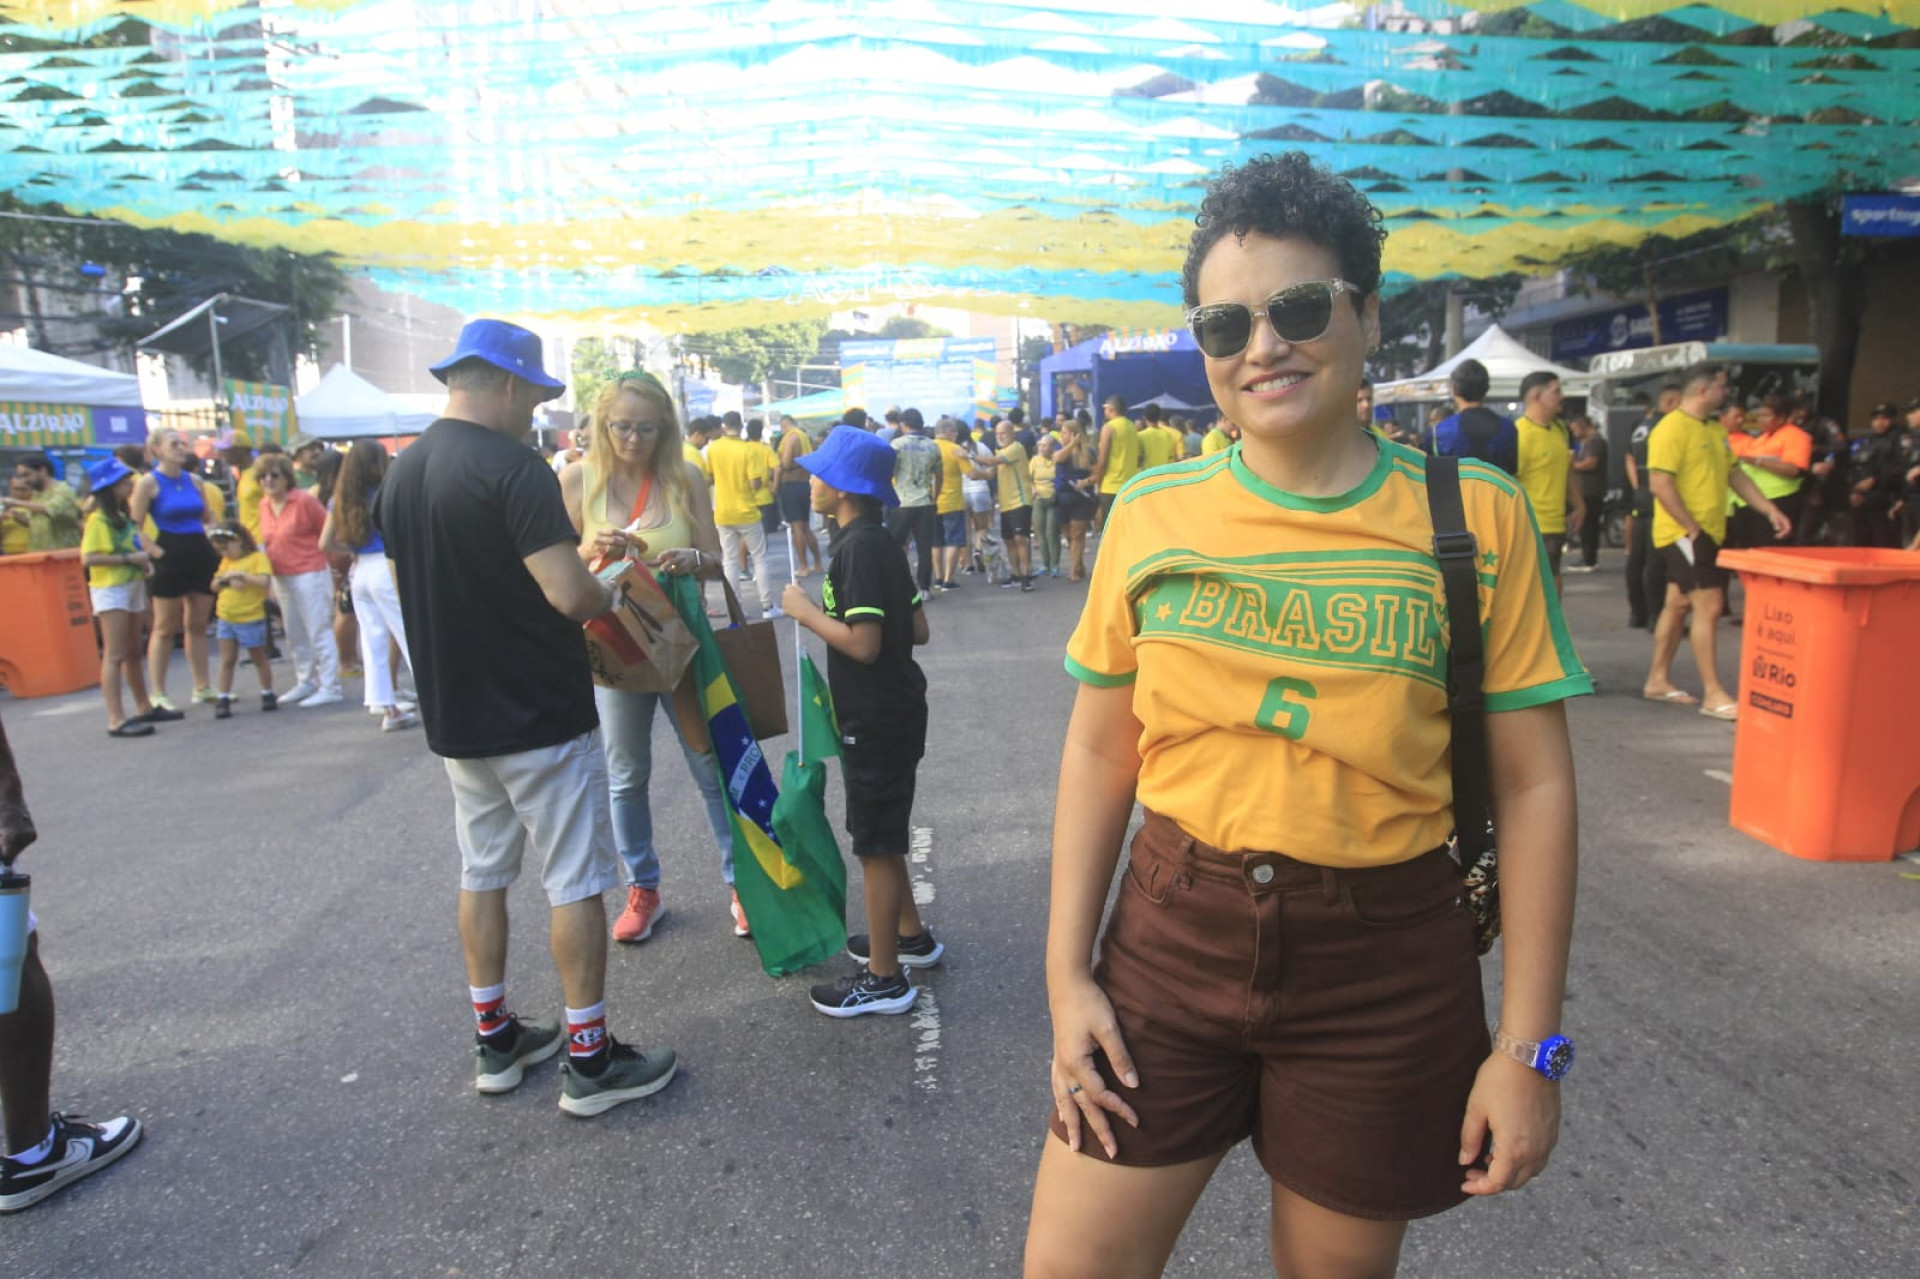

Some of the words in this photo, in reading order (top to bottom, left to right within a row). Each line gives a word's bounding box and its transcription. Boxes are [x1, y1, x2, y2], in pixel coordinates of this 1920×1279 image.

[1179, 574, 1436, 667] BRASIL
[1764, 604, 1794, 625] Lixo
[1769, 664, 1796, 688] Rio
[1254, 675, 1318, 740] 6
